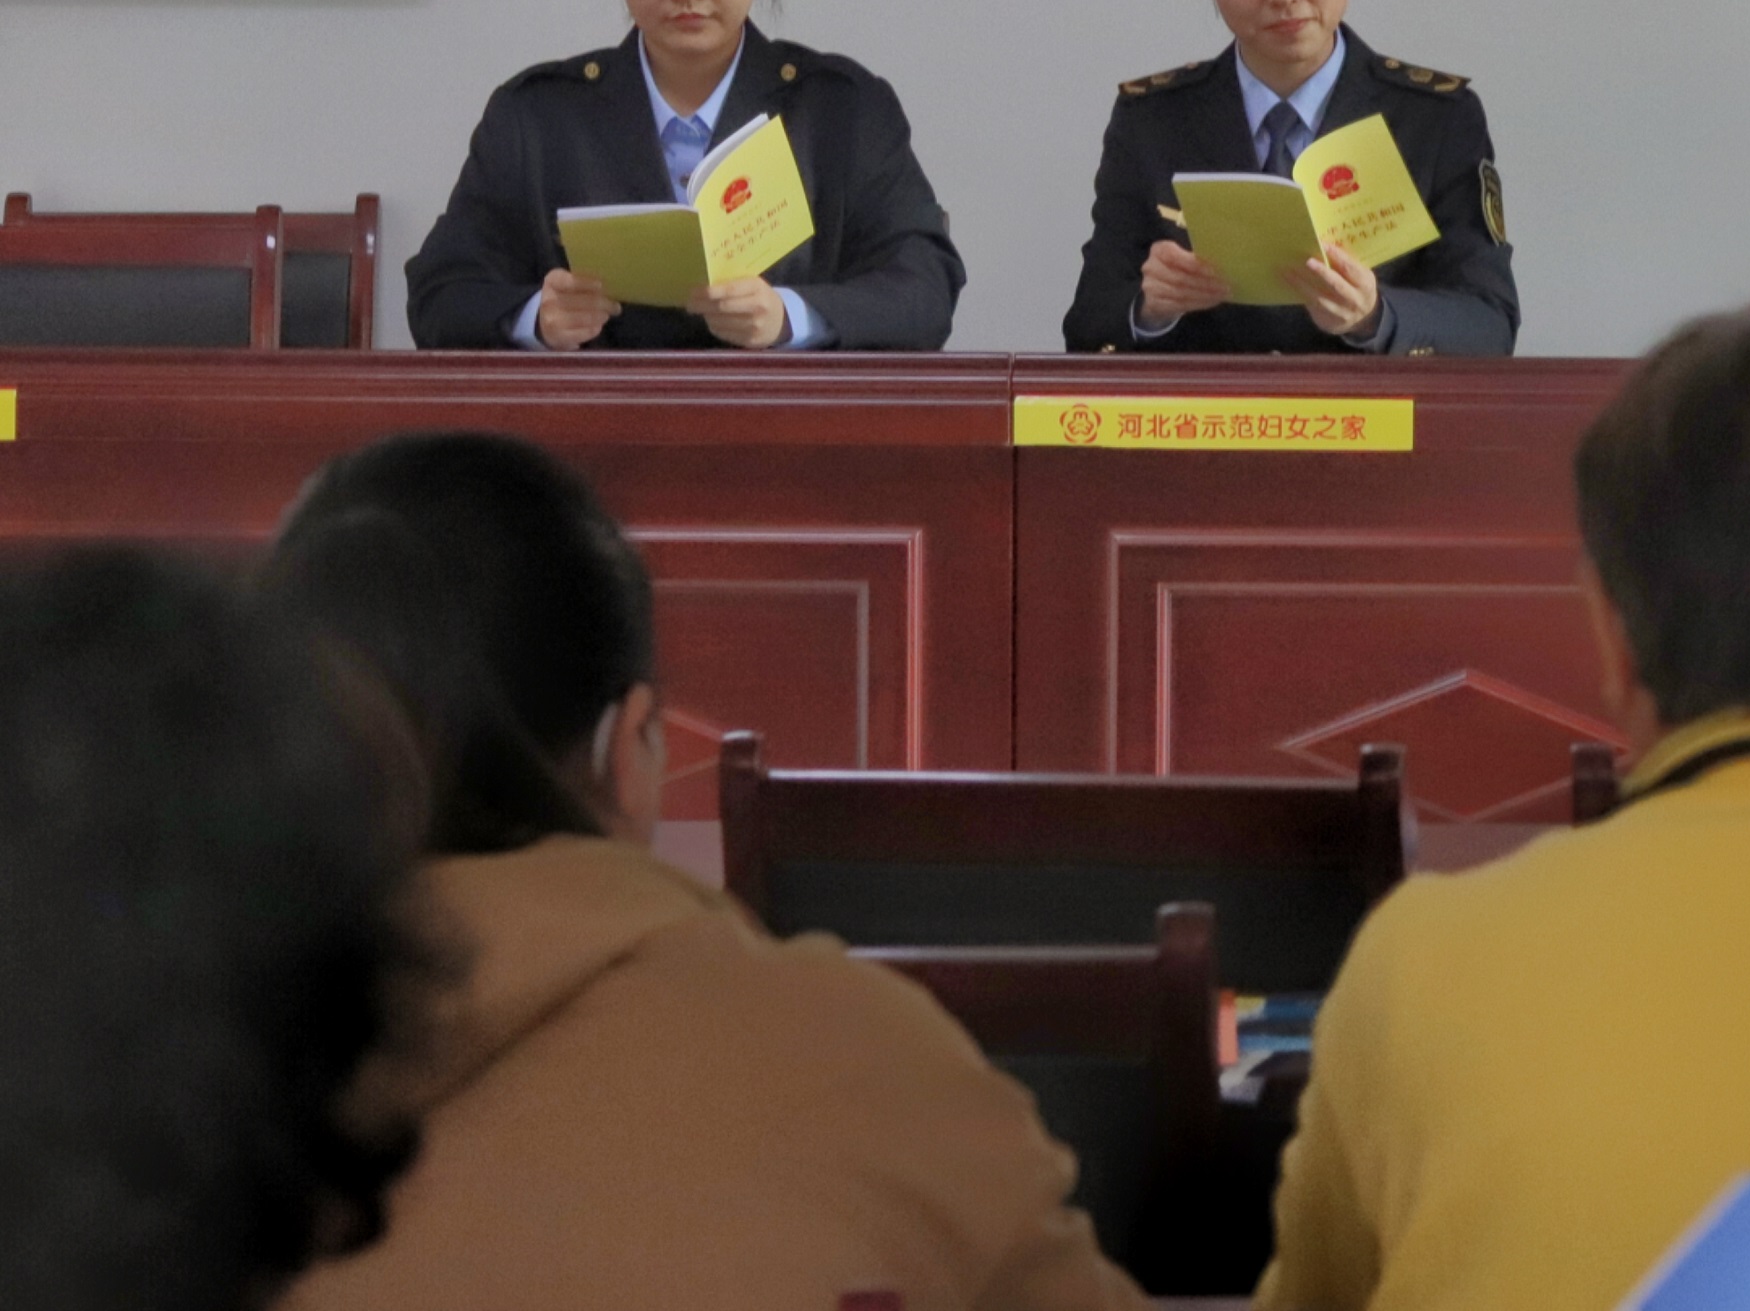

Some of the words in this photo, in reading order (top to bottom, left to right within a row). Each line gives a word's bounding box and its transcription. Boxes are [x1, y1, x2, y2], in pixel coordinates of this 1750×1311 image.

[1118, 413, 1366, 441] 河北省示范妇女之家
